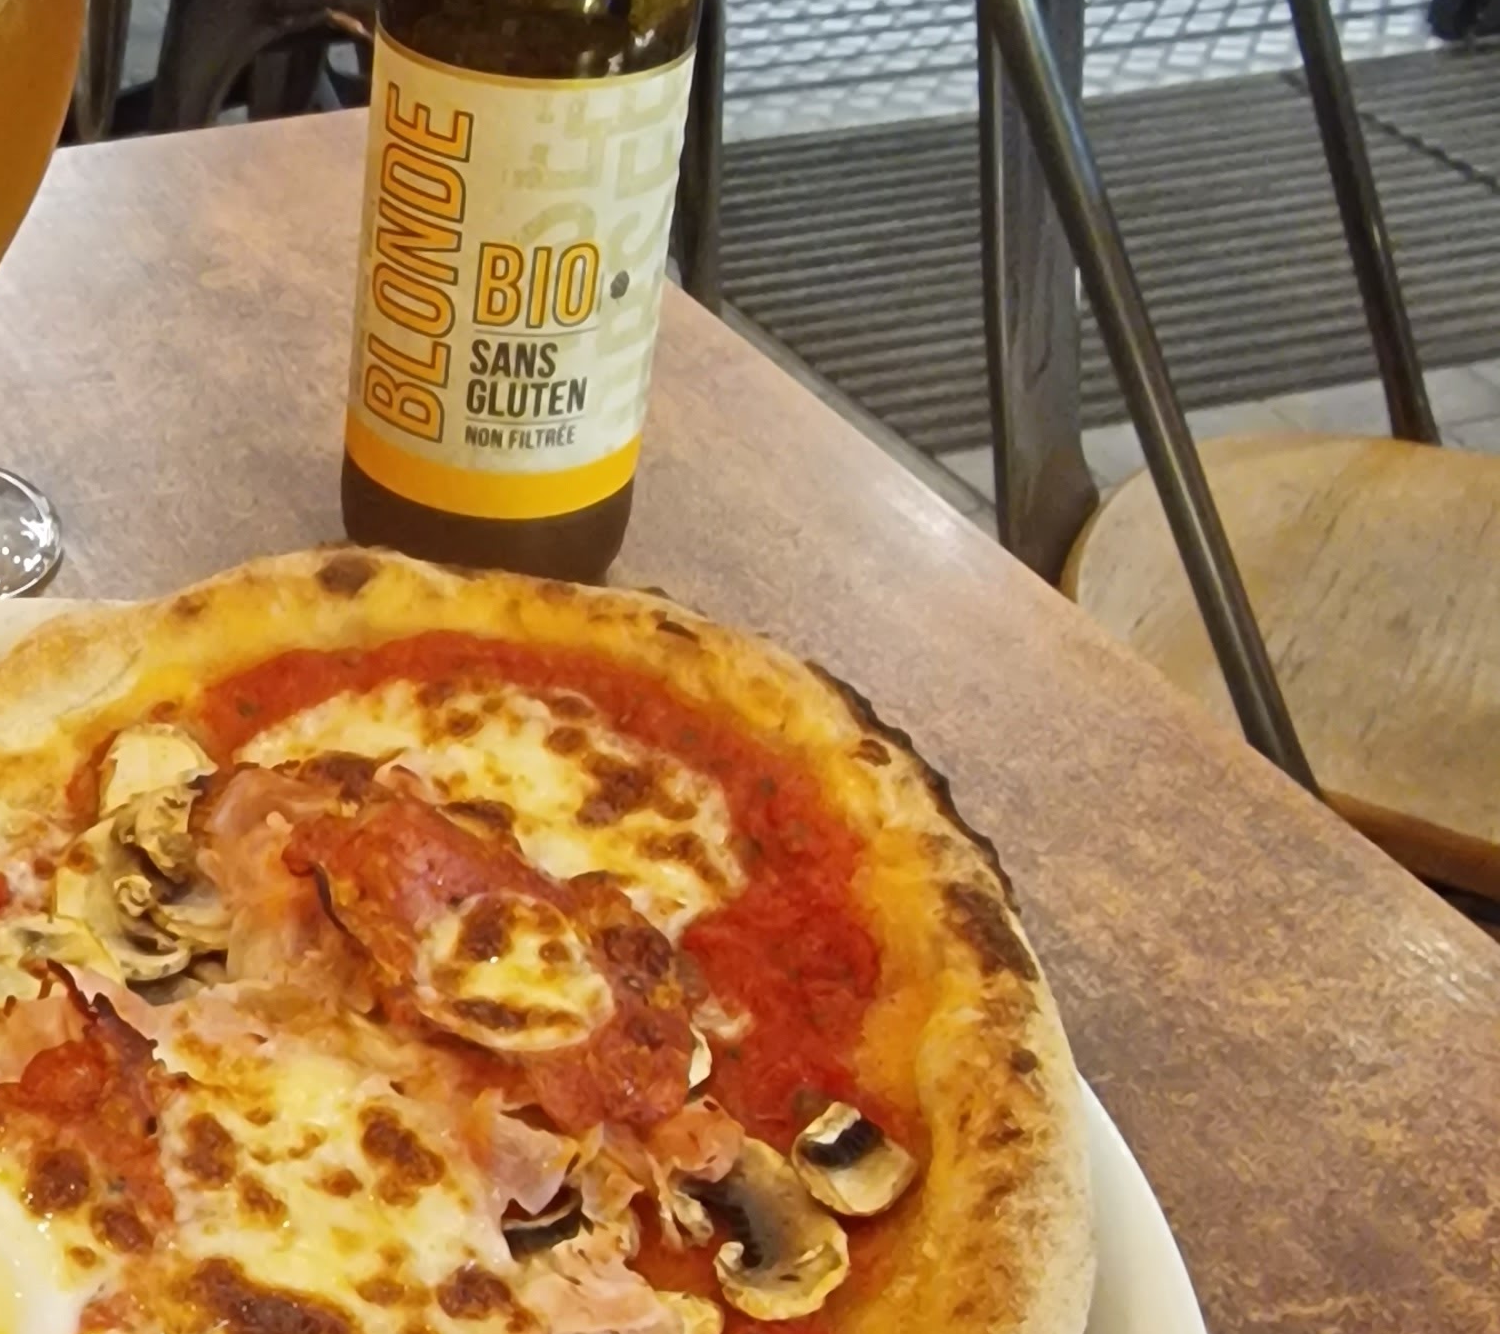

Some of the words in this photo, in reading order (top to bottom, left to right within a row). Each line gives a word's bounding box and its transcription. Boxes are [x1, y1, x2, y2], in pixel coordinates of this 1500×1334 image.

[365, 82, 474, 443] BLONDE
[471, 242, 602, 329] BIO
[469, 338, 559, 379] SANS
[465, 376, 588, 419] GLUTEN
[464, 423, 505, 450] NON
[506, 422, 577, 451] FILTRÉE
